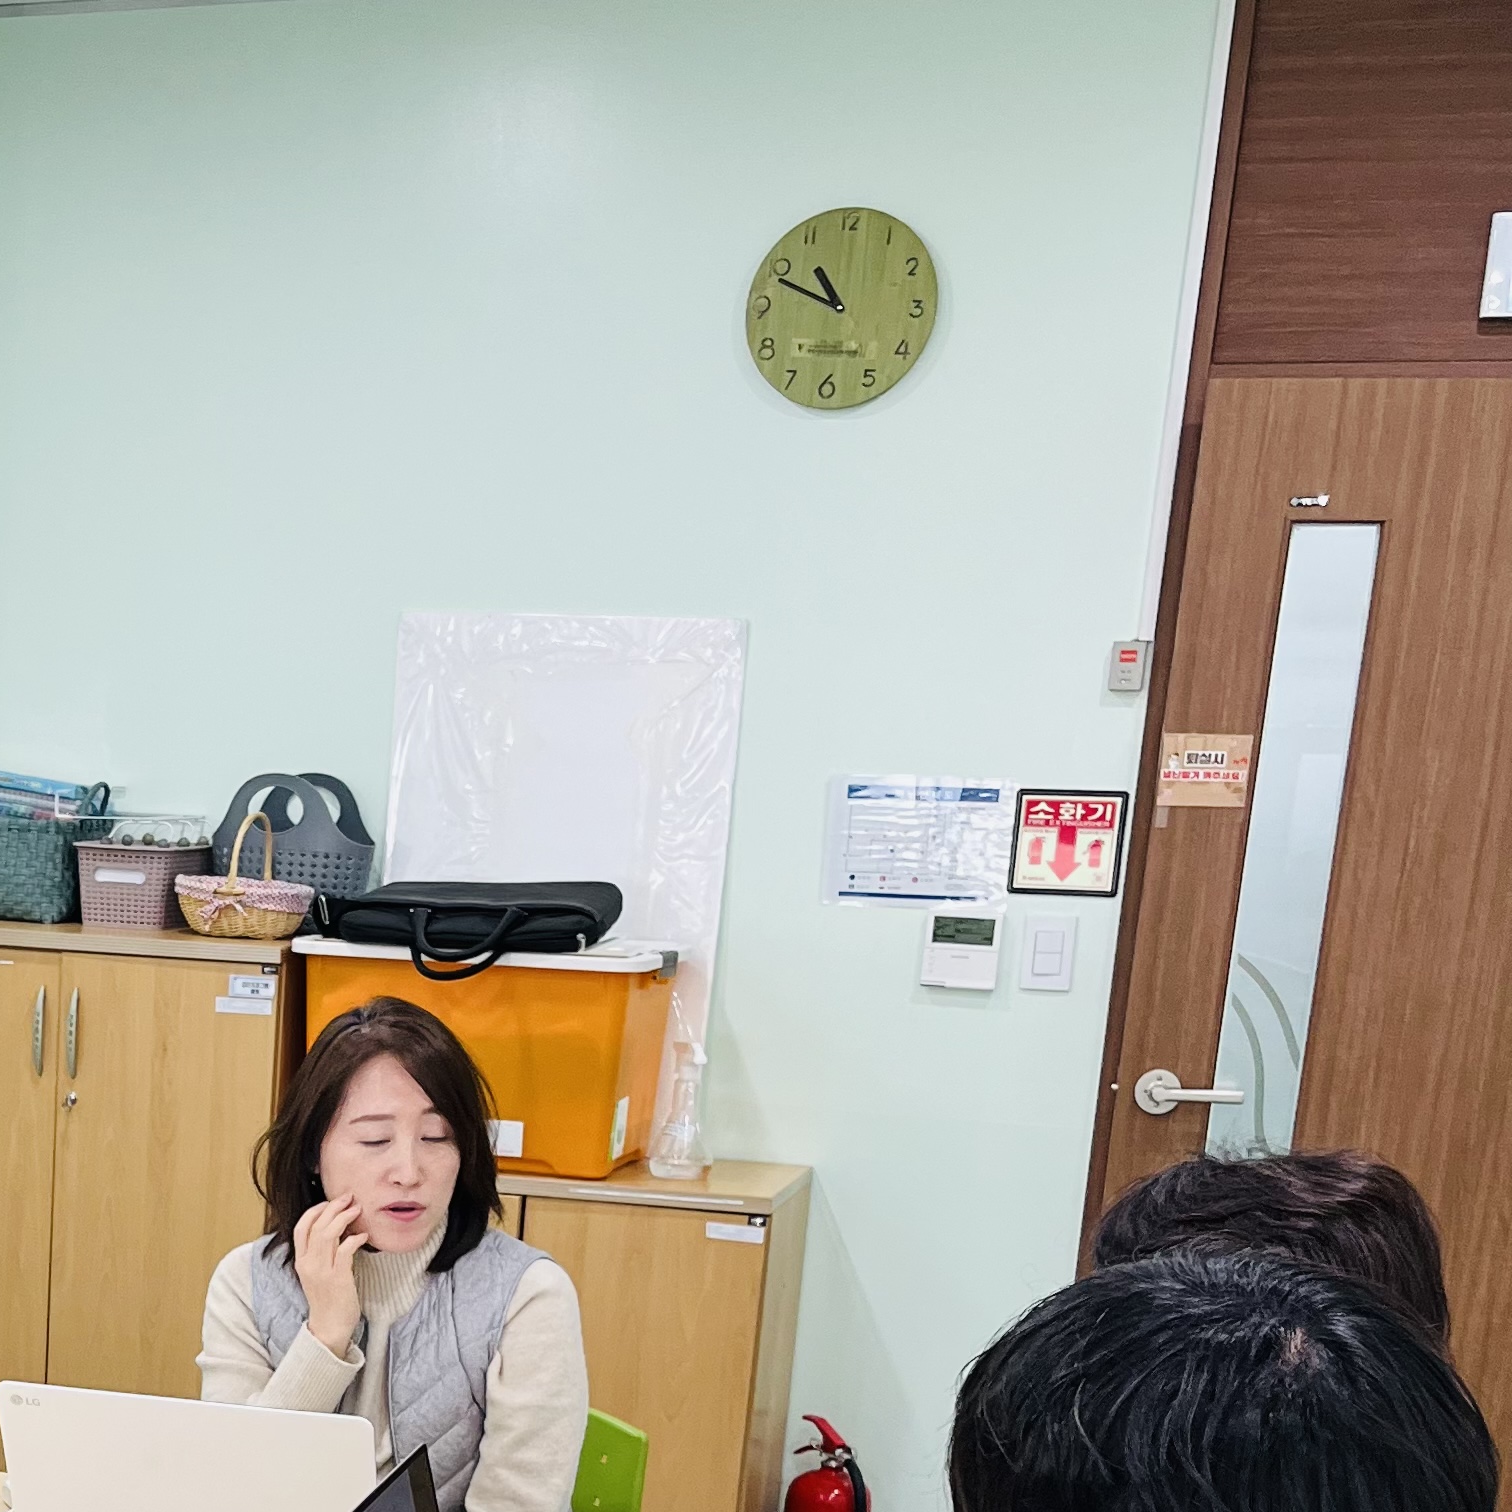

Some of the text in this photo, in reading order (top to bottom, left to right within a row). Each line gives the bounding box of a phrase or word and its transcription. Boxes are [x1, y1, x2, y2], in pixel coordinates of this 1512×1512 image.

[841, 211, 860, 231] 12
[803, 225, 817, 245] 11
[886, 225, 892, 246] 1
[768, 258, 792, 278] 10
[905, 257, 919, 276] 2
[752, 295, 771, 319] 9
[908, 300, 924, 318] 3
[757, 337, 775, 360] 8
[894, 339, 911, 360] 4
[785, 370, 797, 390] 7
[817, 374, 835, 399] 6
[861, 369, 876, 387] 5
[1028, 801, 1113, 821] 소화기
[25, 1397, 40, 1406] LG
